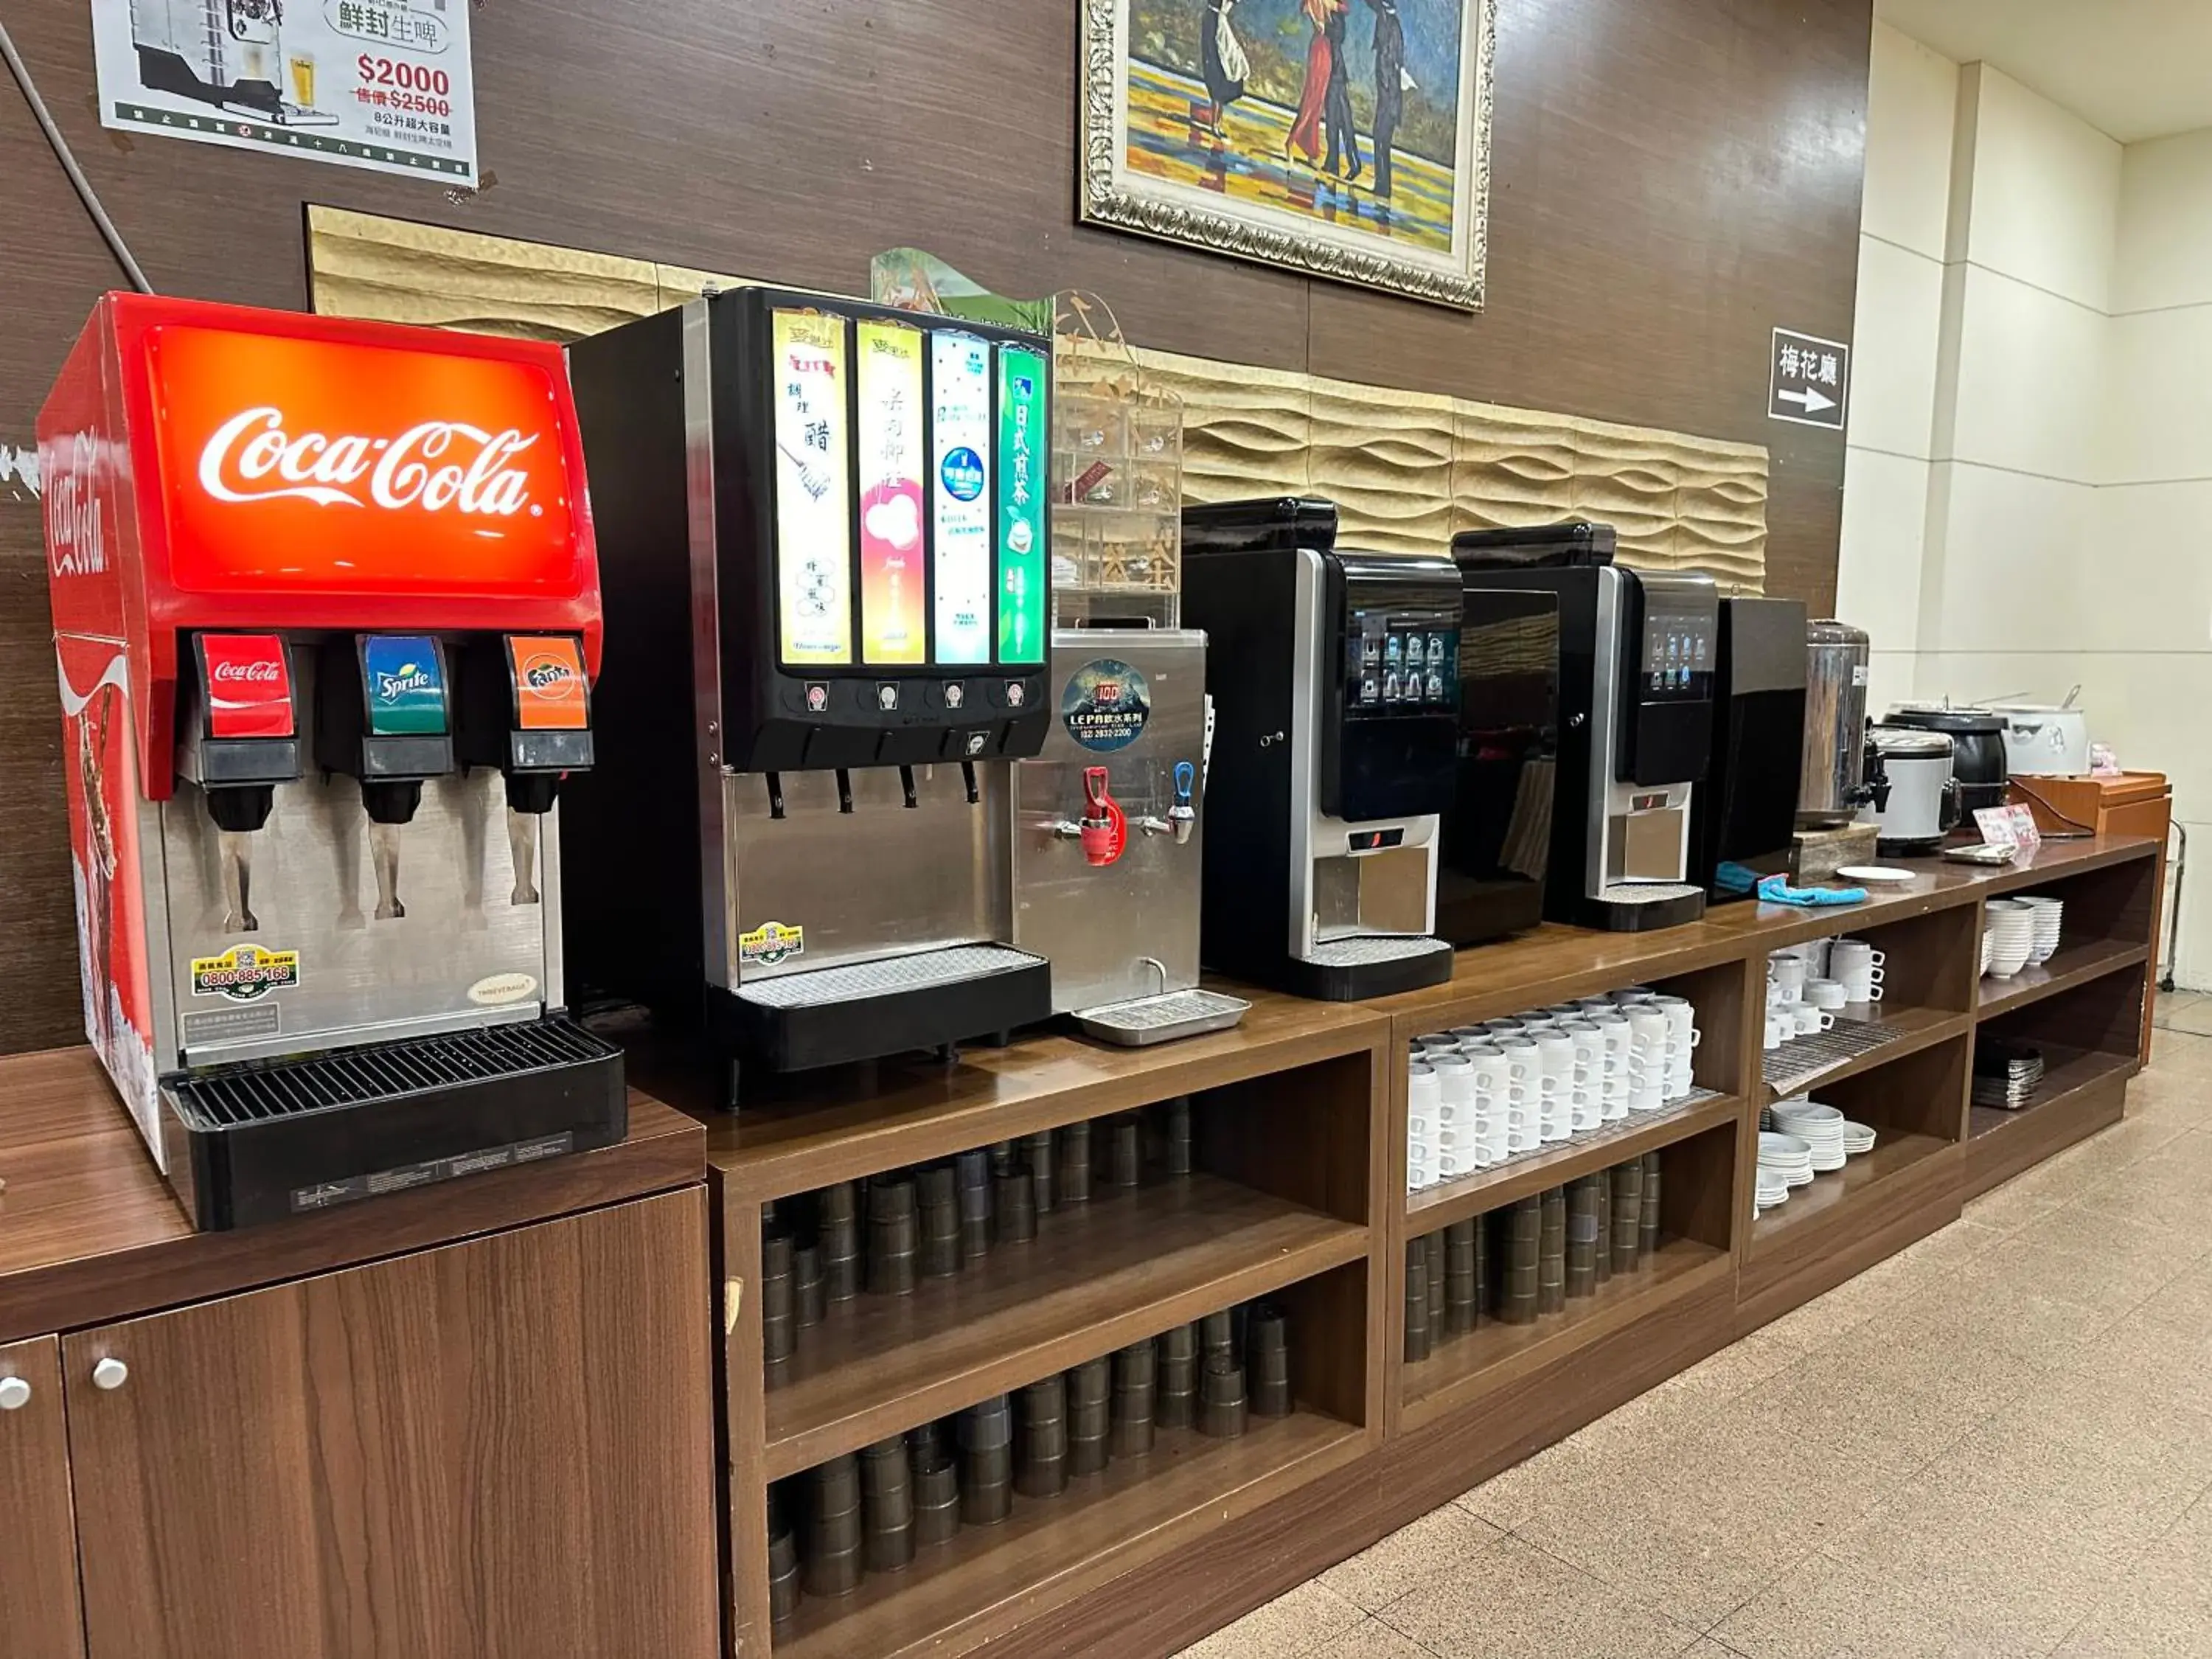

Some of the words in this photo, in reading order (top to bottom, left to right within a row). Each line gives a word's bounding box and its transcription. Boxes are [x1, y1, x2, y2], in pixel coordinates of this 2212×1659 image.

[339, 1, 437, 47] 鮮封生啤
[358, 53, 449, 96] $2000
[374, 111, 451, 136] 8公升超大容量
[1778, 343, 1837, 387] 梅花廳
[198, 406, 540, 516] Coca-Cola
[215, 661, 281, 681] Coca-Cola
[381, 671, 428, 698] Sprite
[527, 665, 571, 687] Fanta
